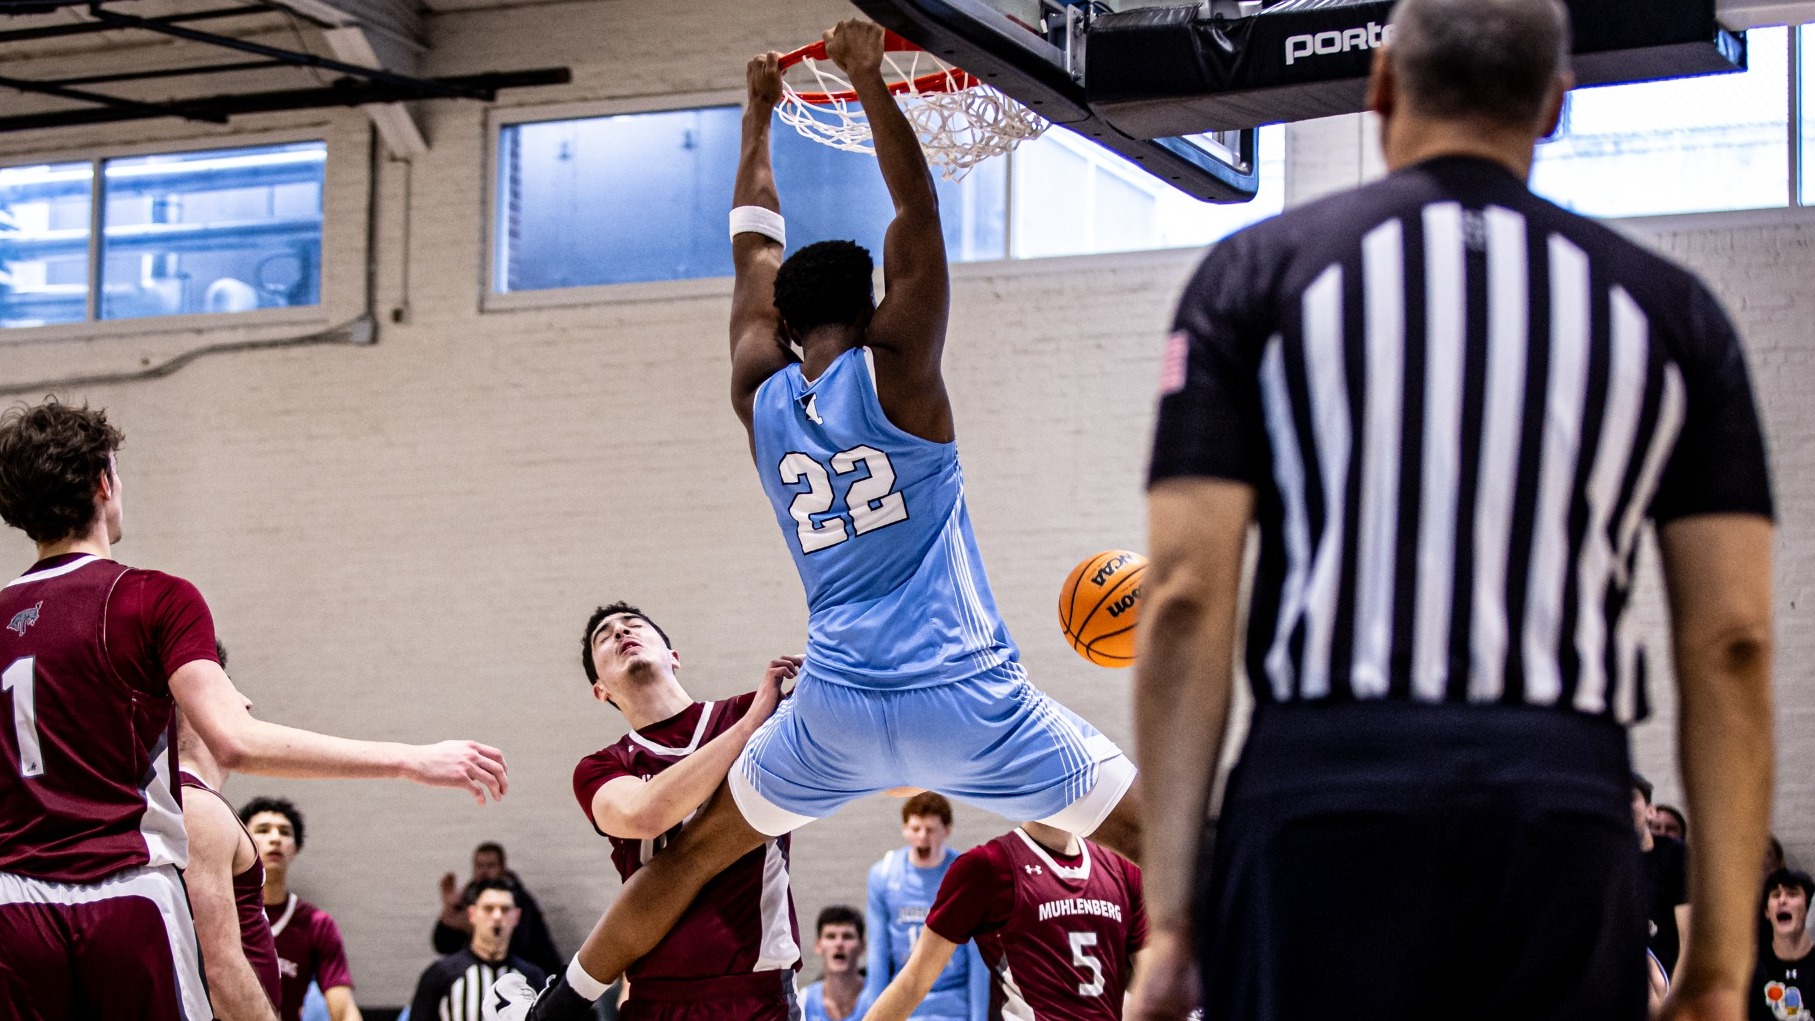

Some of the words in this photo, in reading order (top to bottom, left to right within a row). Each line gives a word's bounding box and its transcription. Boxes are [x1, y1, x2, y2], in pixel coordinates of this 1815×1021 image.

[778, 444, 910, 556] 22
[1, 655, 46, 778] 1
[1038, 897, 1122, 923] MUHLENBERG
[1068, 932, 1106, 998] 5
